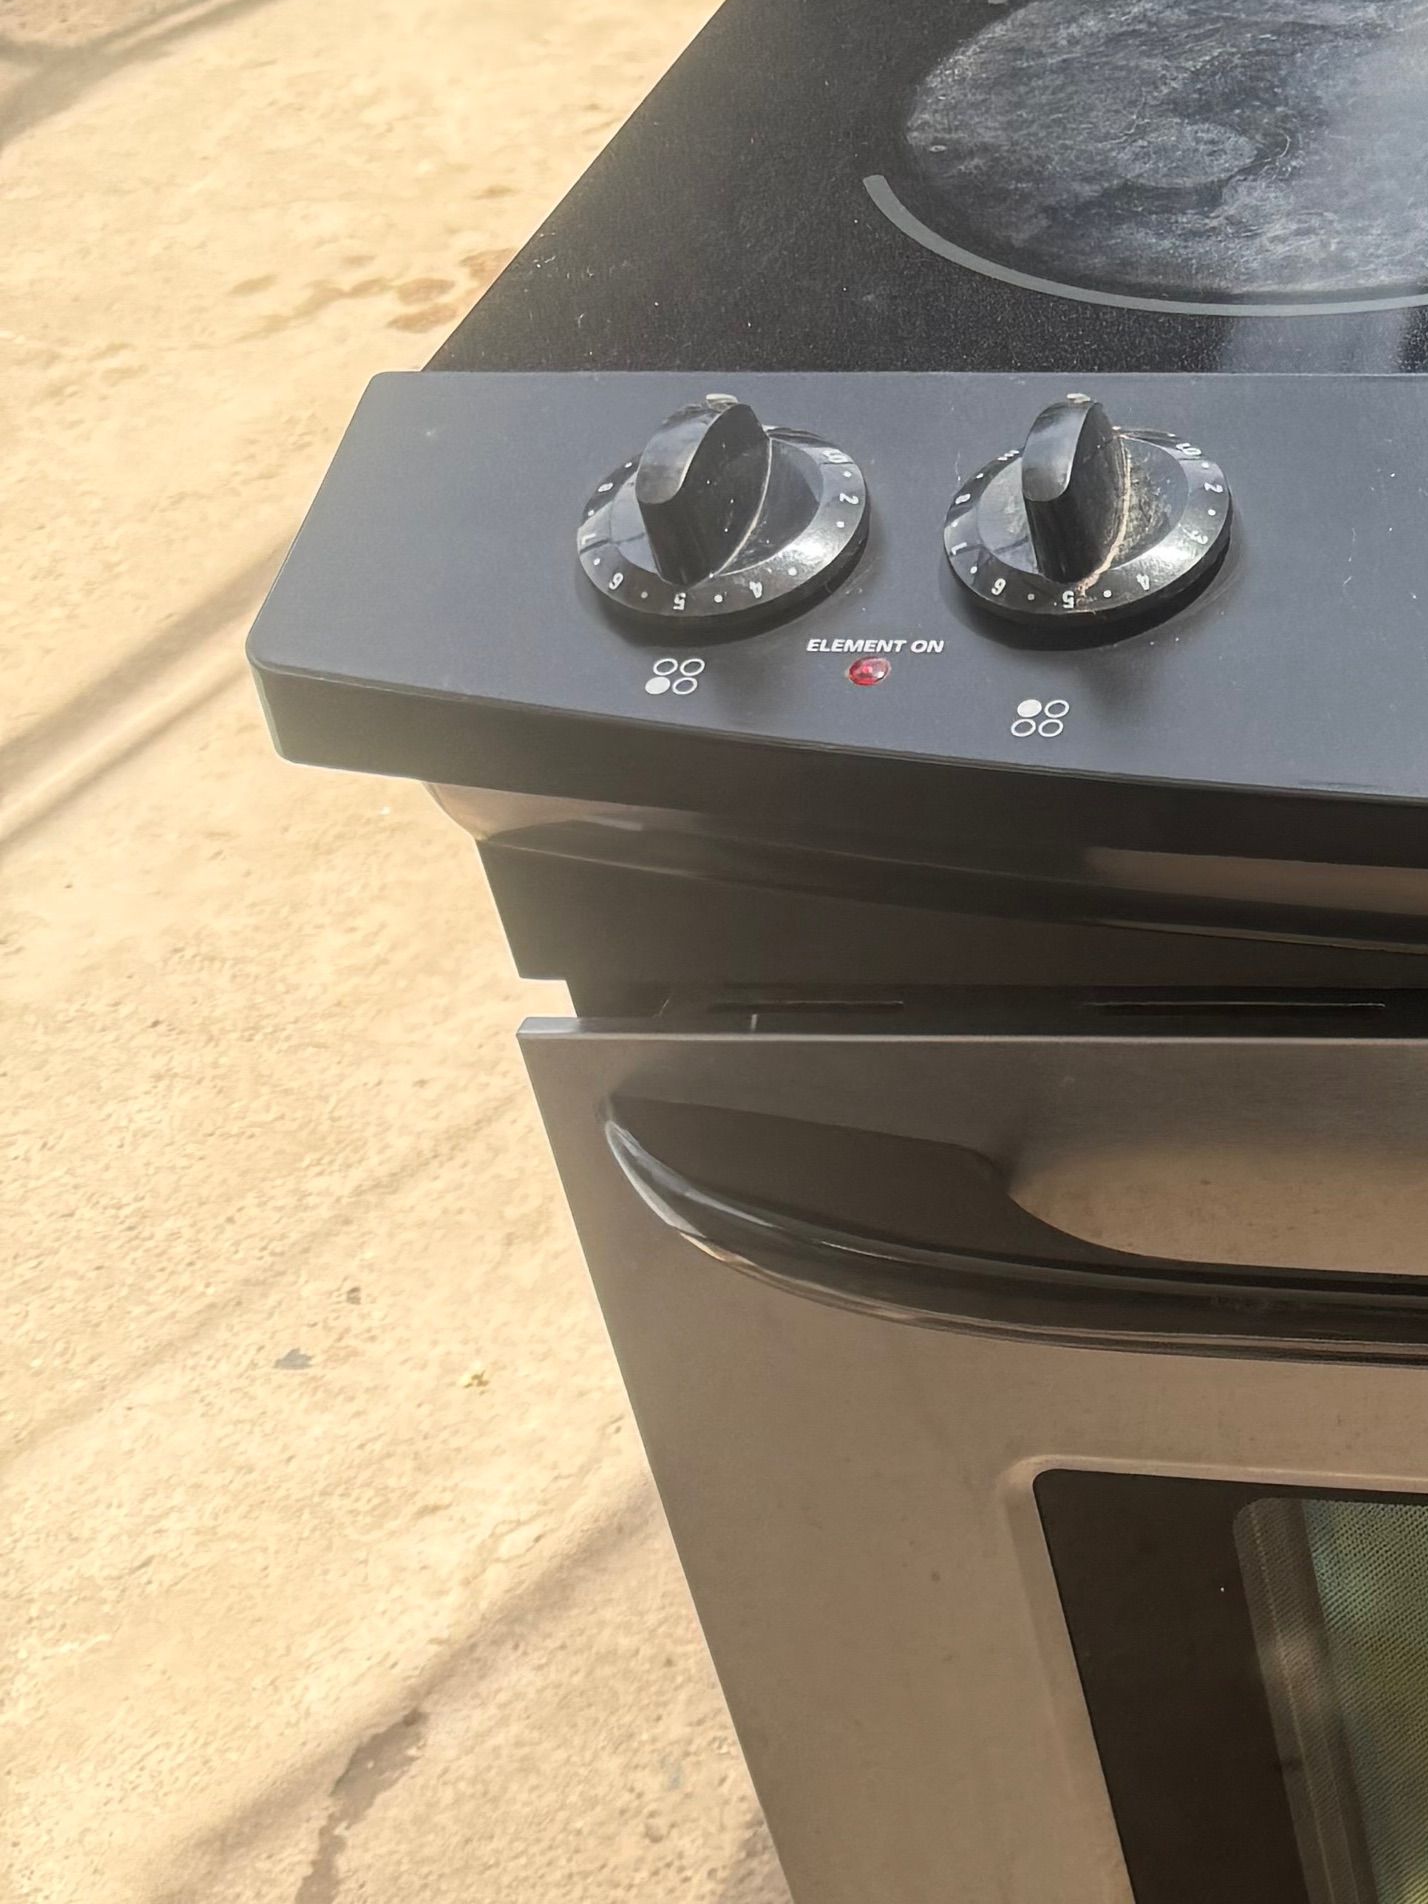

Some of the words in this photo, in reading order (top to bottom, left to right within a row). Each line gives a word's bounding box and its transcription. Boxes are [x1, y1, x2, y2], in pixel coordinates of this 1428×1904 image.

[839, 492, 860, 505] 2
[608, 571, 625, 590] 6
[991, 577, 1007, 596] 6
[672, 592, 688, 611] 5
[1061, 590, 1076, 609] 5
[806, 638, 907, 653] ELEMENT
[911, 639, 945, 653] ON
